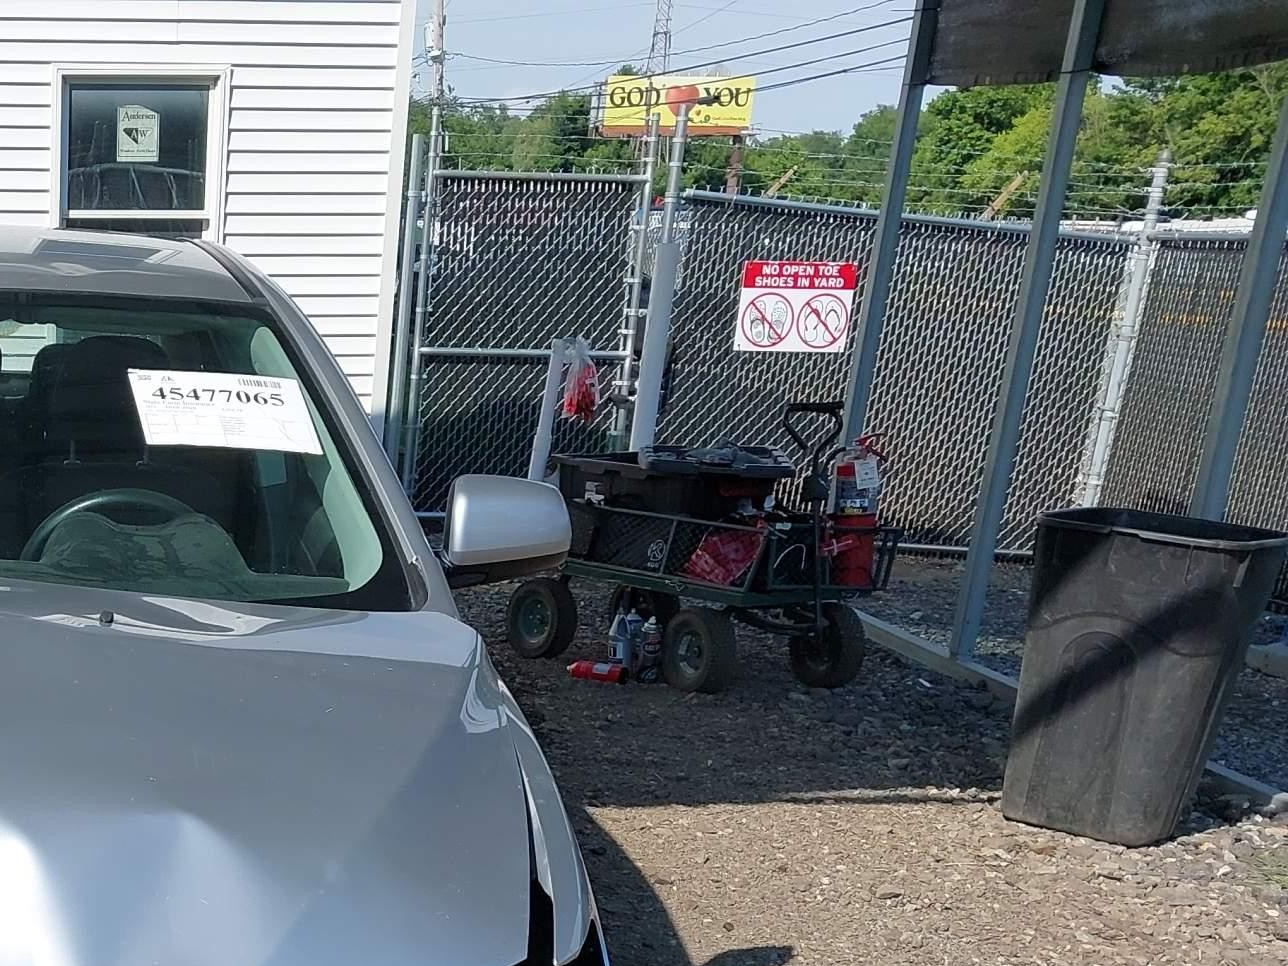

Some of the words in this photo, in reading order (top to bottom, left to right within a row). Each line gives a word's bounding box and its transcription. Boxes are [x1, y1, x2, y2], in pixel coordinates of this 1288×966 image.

[610, 86, 660, 107] GOD
[703, 87, 751, 107] YOU
[122, 111, 156, 121] Andersen
[762, 265, 780, 275] NO
[783, 265, 814, 276] OPEN
[818, 266, 840, 276] TOE
[755, 277, 794, 287] SHOES
[797, 278, 810, 287] IN
[813, 278, 844, 287] YARD
[151, 386, 285, 407] 45477065
